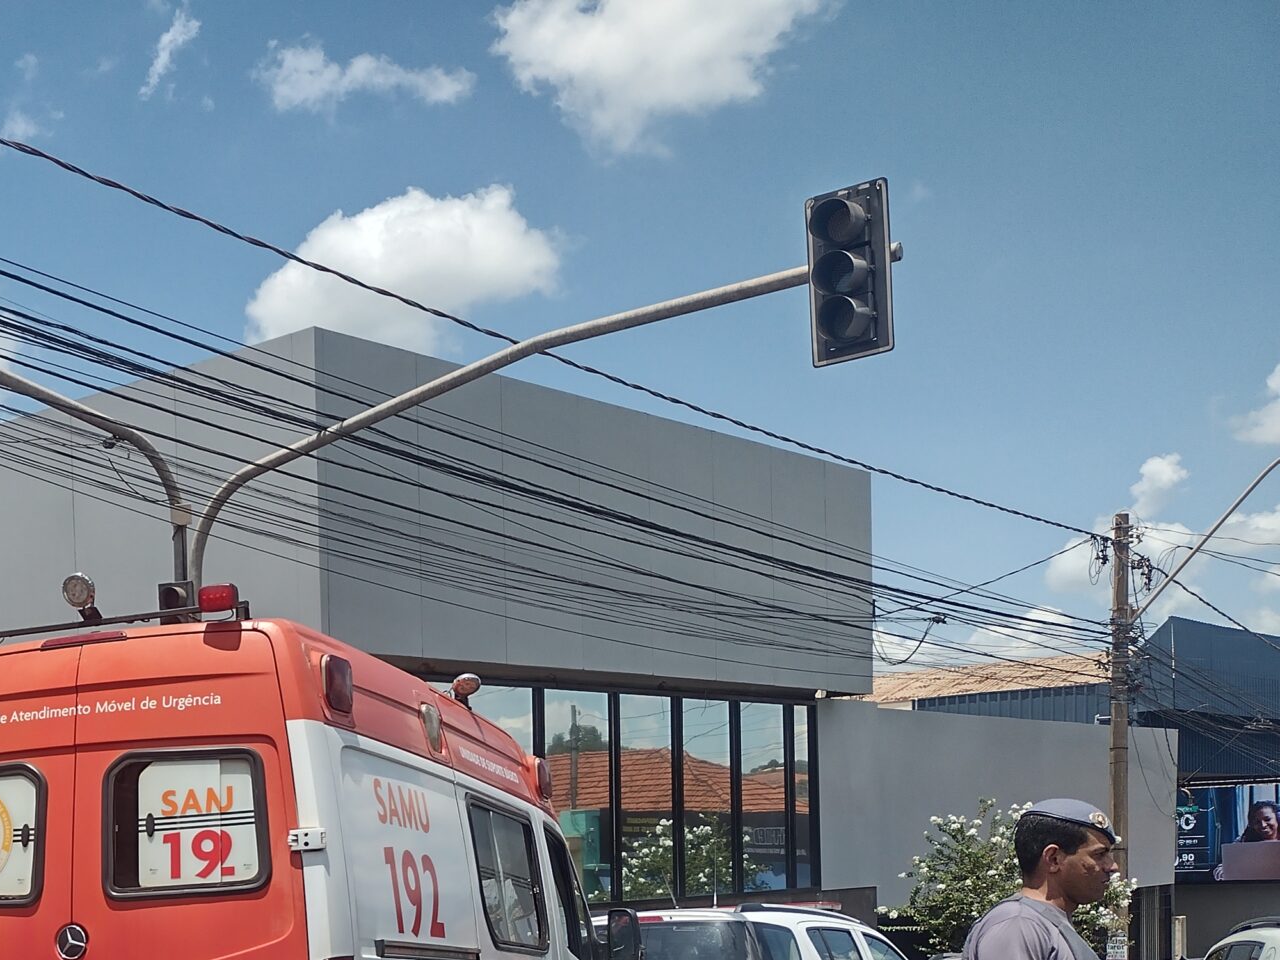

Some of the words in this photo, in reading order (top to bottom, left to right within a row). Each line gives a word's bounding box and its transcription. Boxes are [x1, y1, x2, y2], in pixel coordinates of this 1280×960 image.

[10, 702, 91, 723] Atendimento
[95, 696, 136, 714] Móvel
[140, 694, 157, 710] de
[161, 692, 222, 711] Urgência
[373, 778, 430, 833] SAMU
[383, 847, 446, 938] 192
